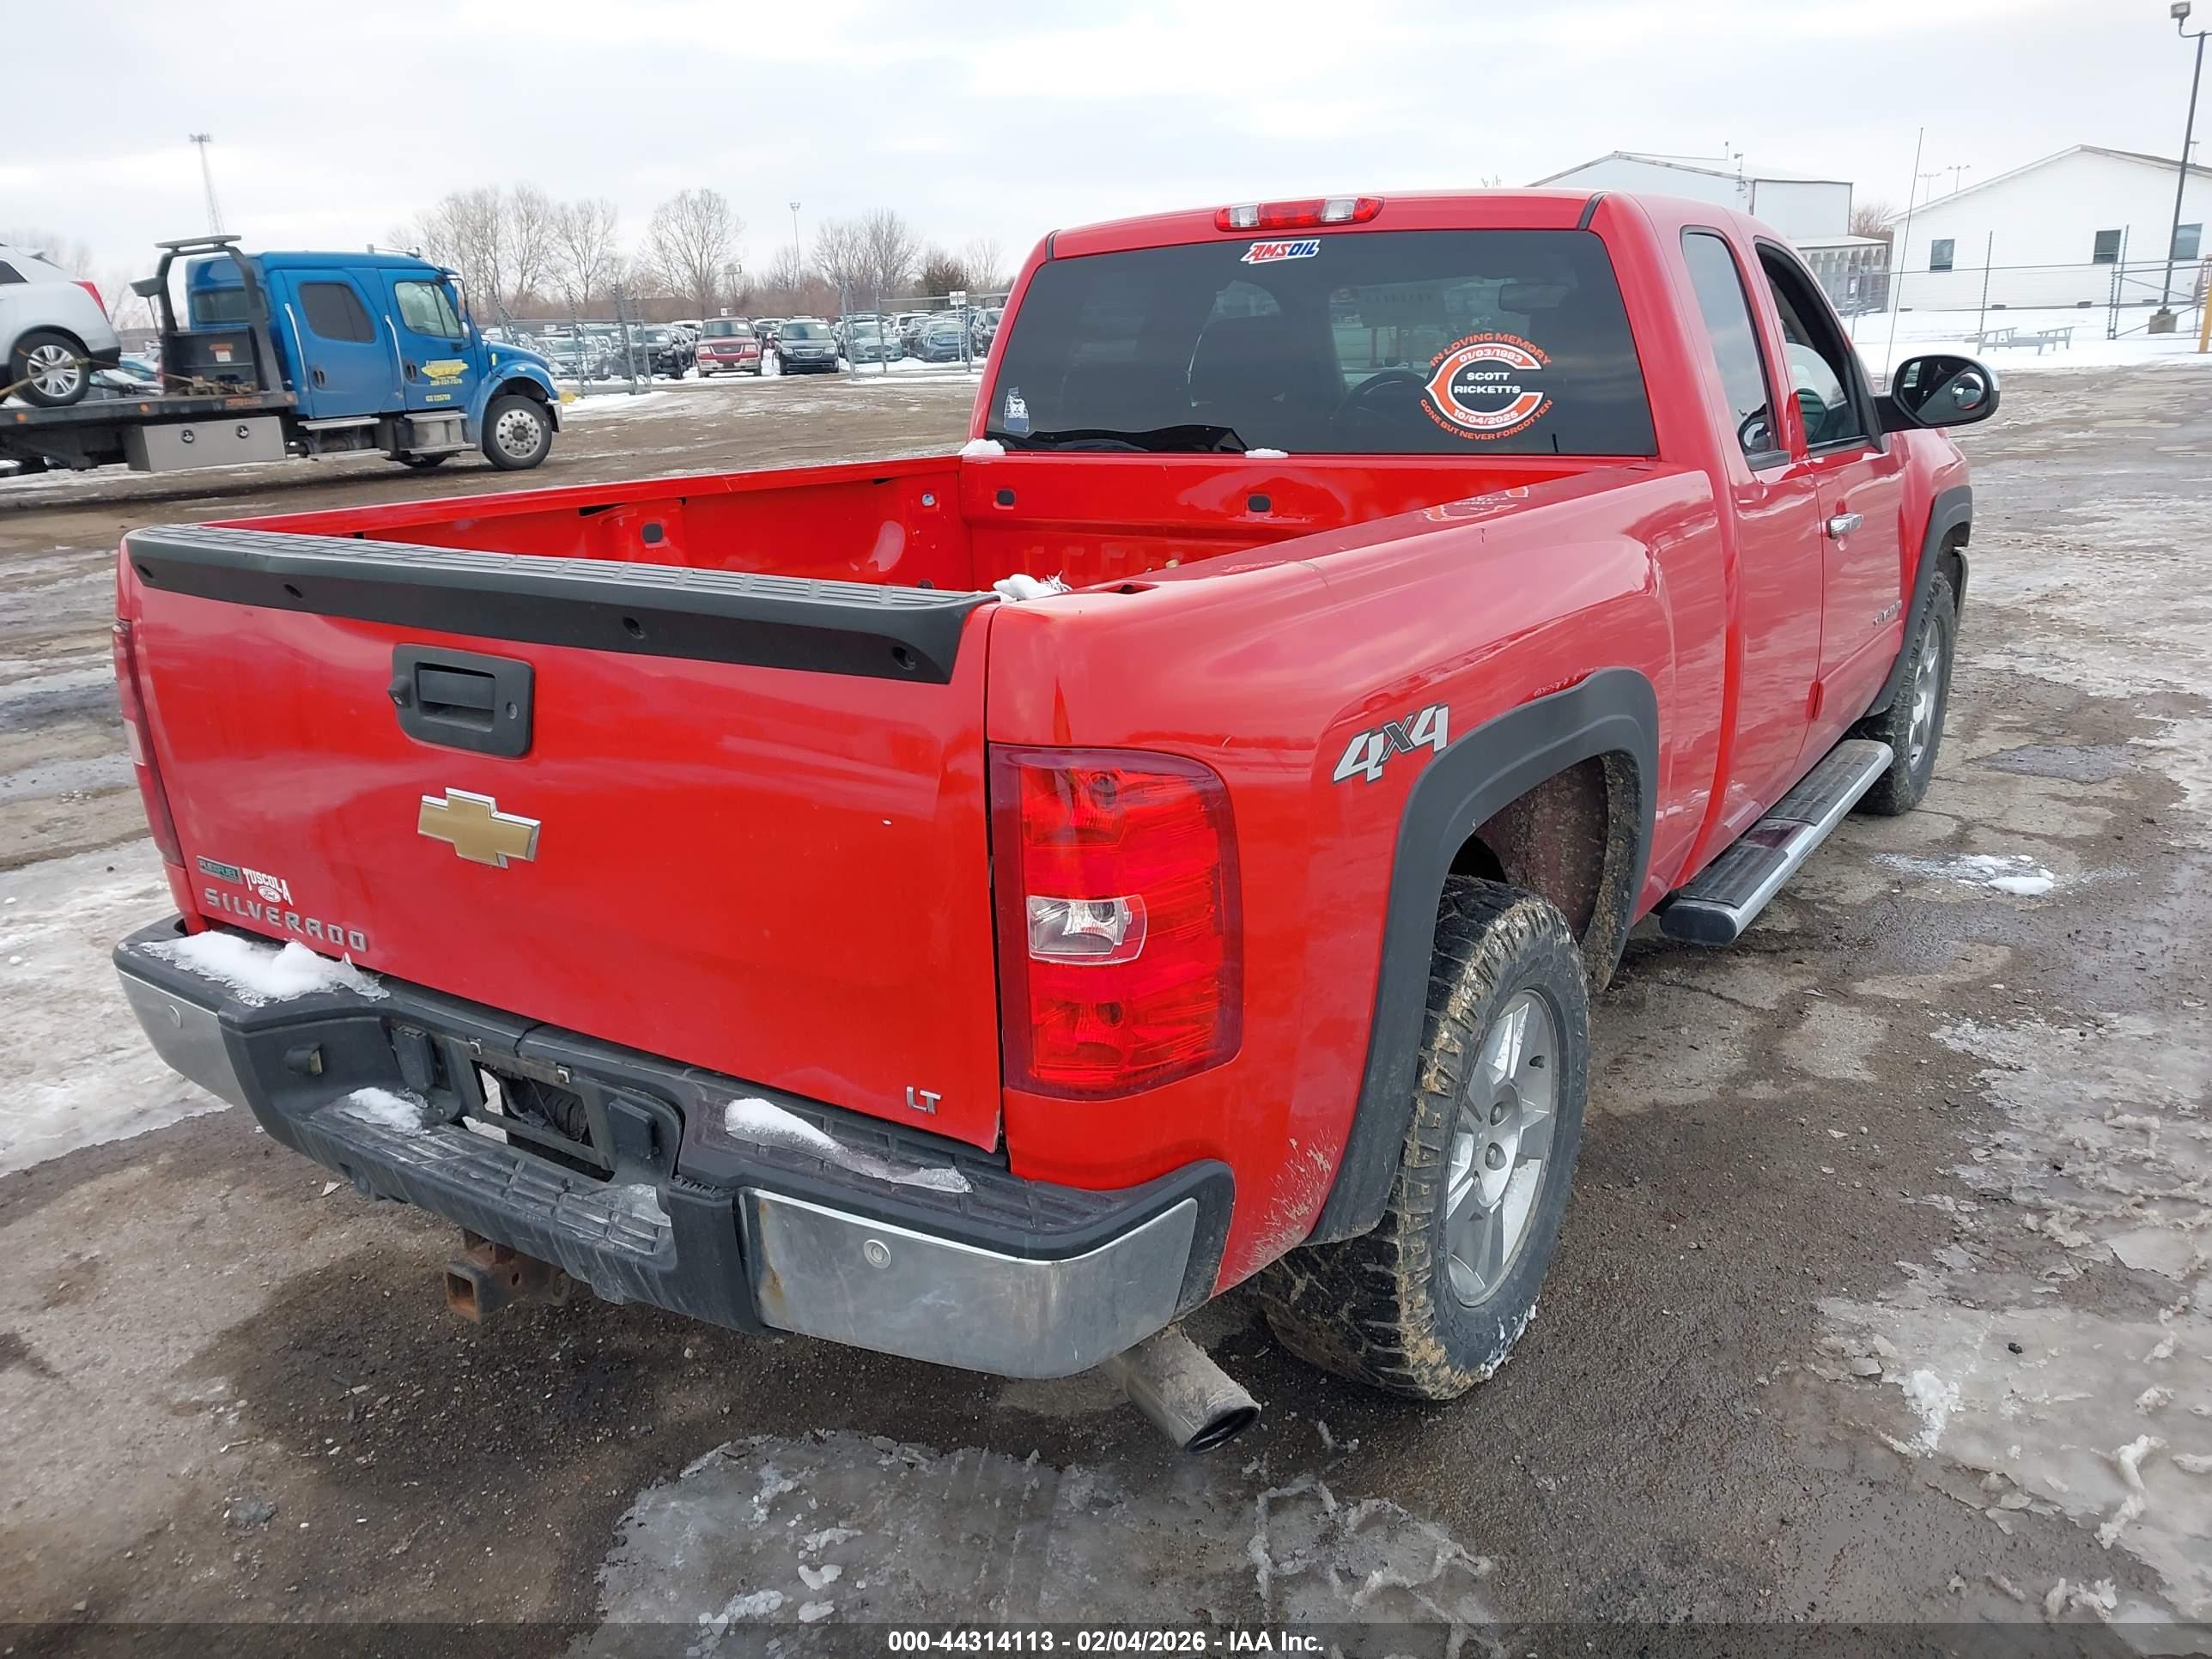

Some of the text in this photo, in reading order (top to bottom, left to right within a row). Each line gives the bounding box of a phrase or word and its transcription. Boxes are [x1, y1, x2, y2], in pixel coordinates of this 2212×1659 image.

[1244, 240, 1319, 263] AMSOIL
[1430, 332, 1553, 367] IN LOVING MEMORY
[1454, 386, 1521, 394] RICKETTS
[1467, 372, 1510, 381] SCOTT
[1459, 430, 1495, 440] NEVER
[1496, 398, 1553, 439] FORGOTTEN
[241, 866, 293, 907] TUSCOLA
[204, 888, 367, 952] SILVERADO
[907, 1085, 941, 1115] LT
